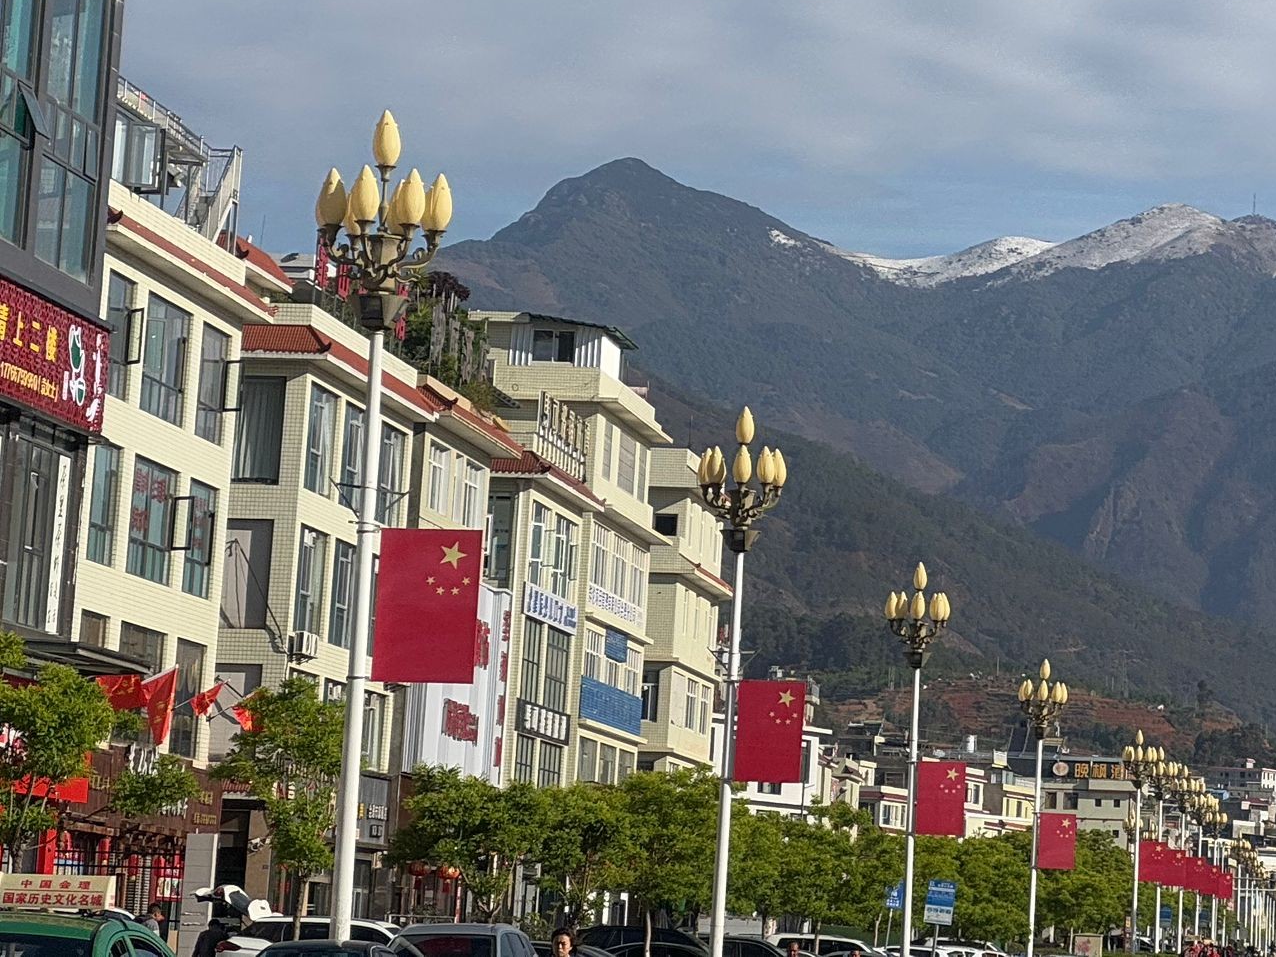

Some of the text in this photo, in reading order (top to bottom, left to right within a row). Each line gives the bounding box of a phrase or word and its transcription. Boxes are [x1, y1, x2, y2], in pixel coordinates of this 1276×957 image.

[21, 879, 91, 890] 中国会理
[2, 892, 103, 906] 国家历史文化名城
